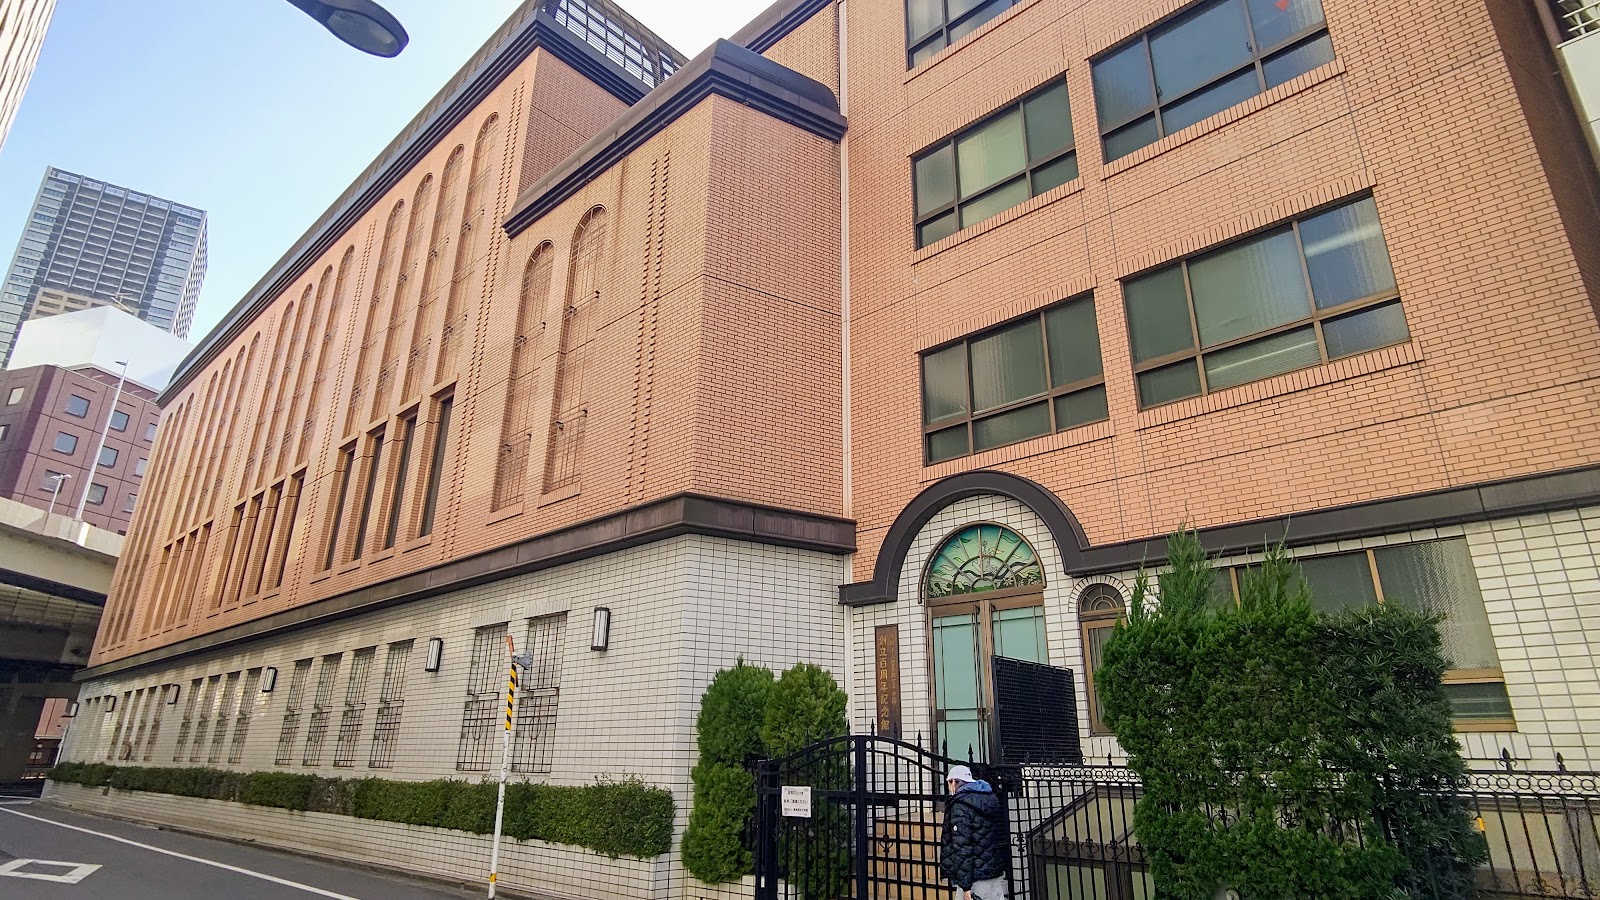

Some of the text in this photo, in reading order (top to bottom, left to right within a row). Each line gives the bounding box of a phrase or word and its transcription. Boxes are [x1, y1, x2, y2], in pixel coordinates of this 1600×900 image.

[879, 635, 890, 731] 創立百周年記念館
